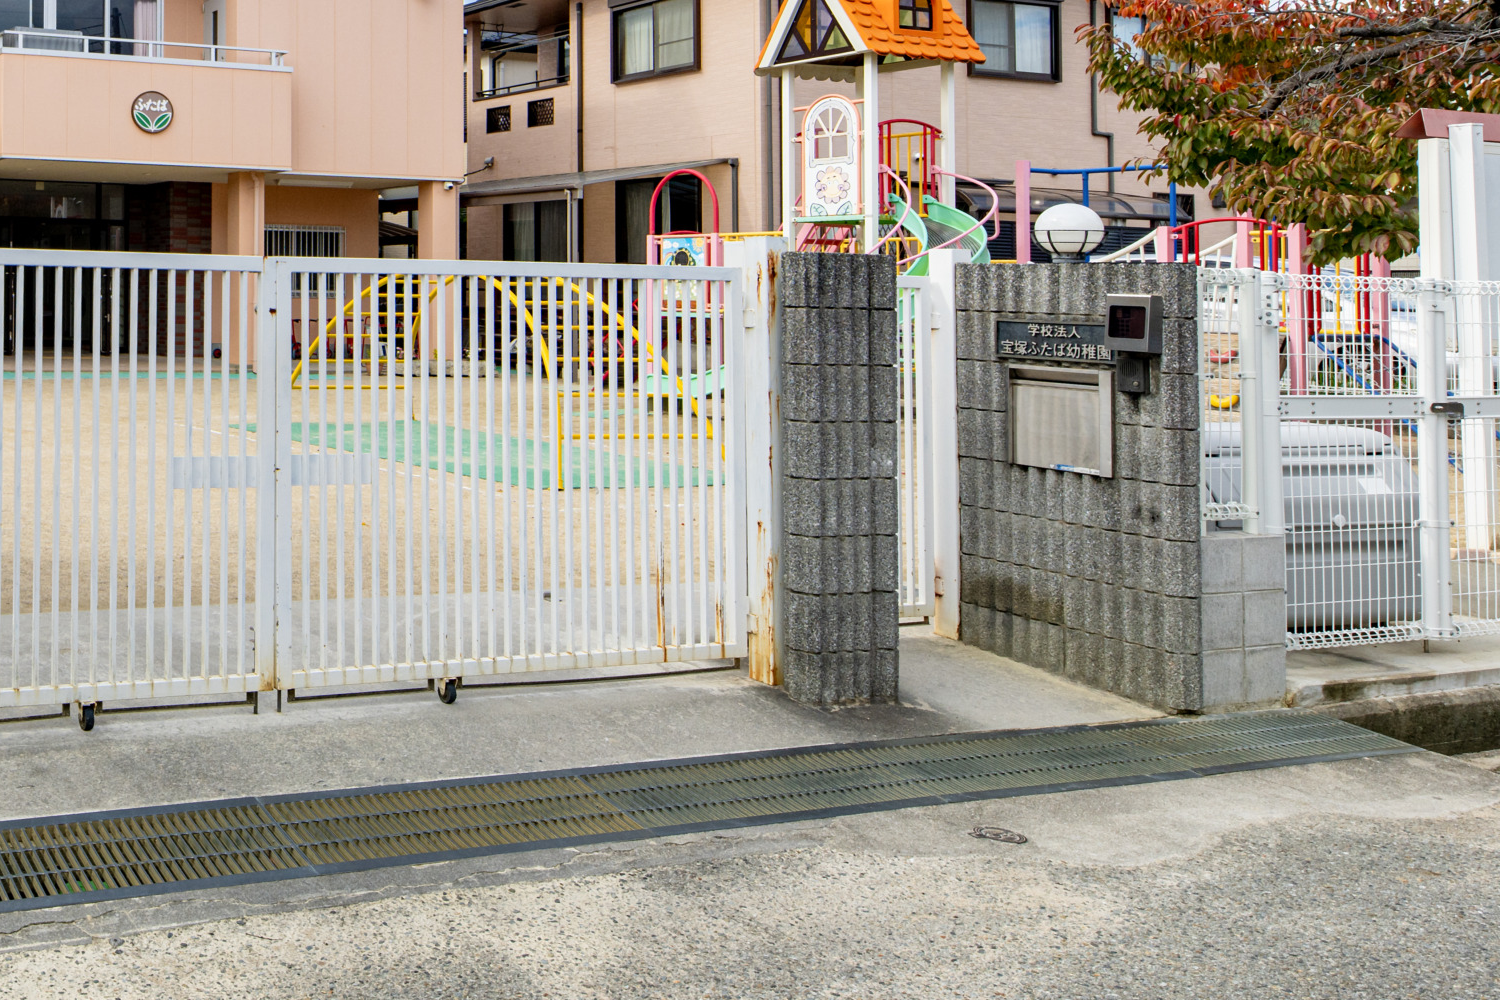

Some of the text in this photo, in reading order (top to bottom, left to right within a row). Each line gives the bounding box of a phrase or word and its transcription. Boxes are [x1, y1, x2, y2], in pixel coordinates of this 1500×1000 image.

[134, 98, 169, 112] ふたば
[1027, 323, 1081, 339] 学校法人
[1000, 339, 1112, 361] 宝塚ふたば幼稚園
